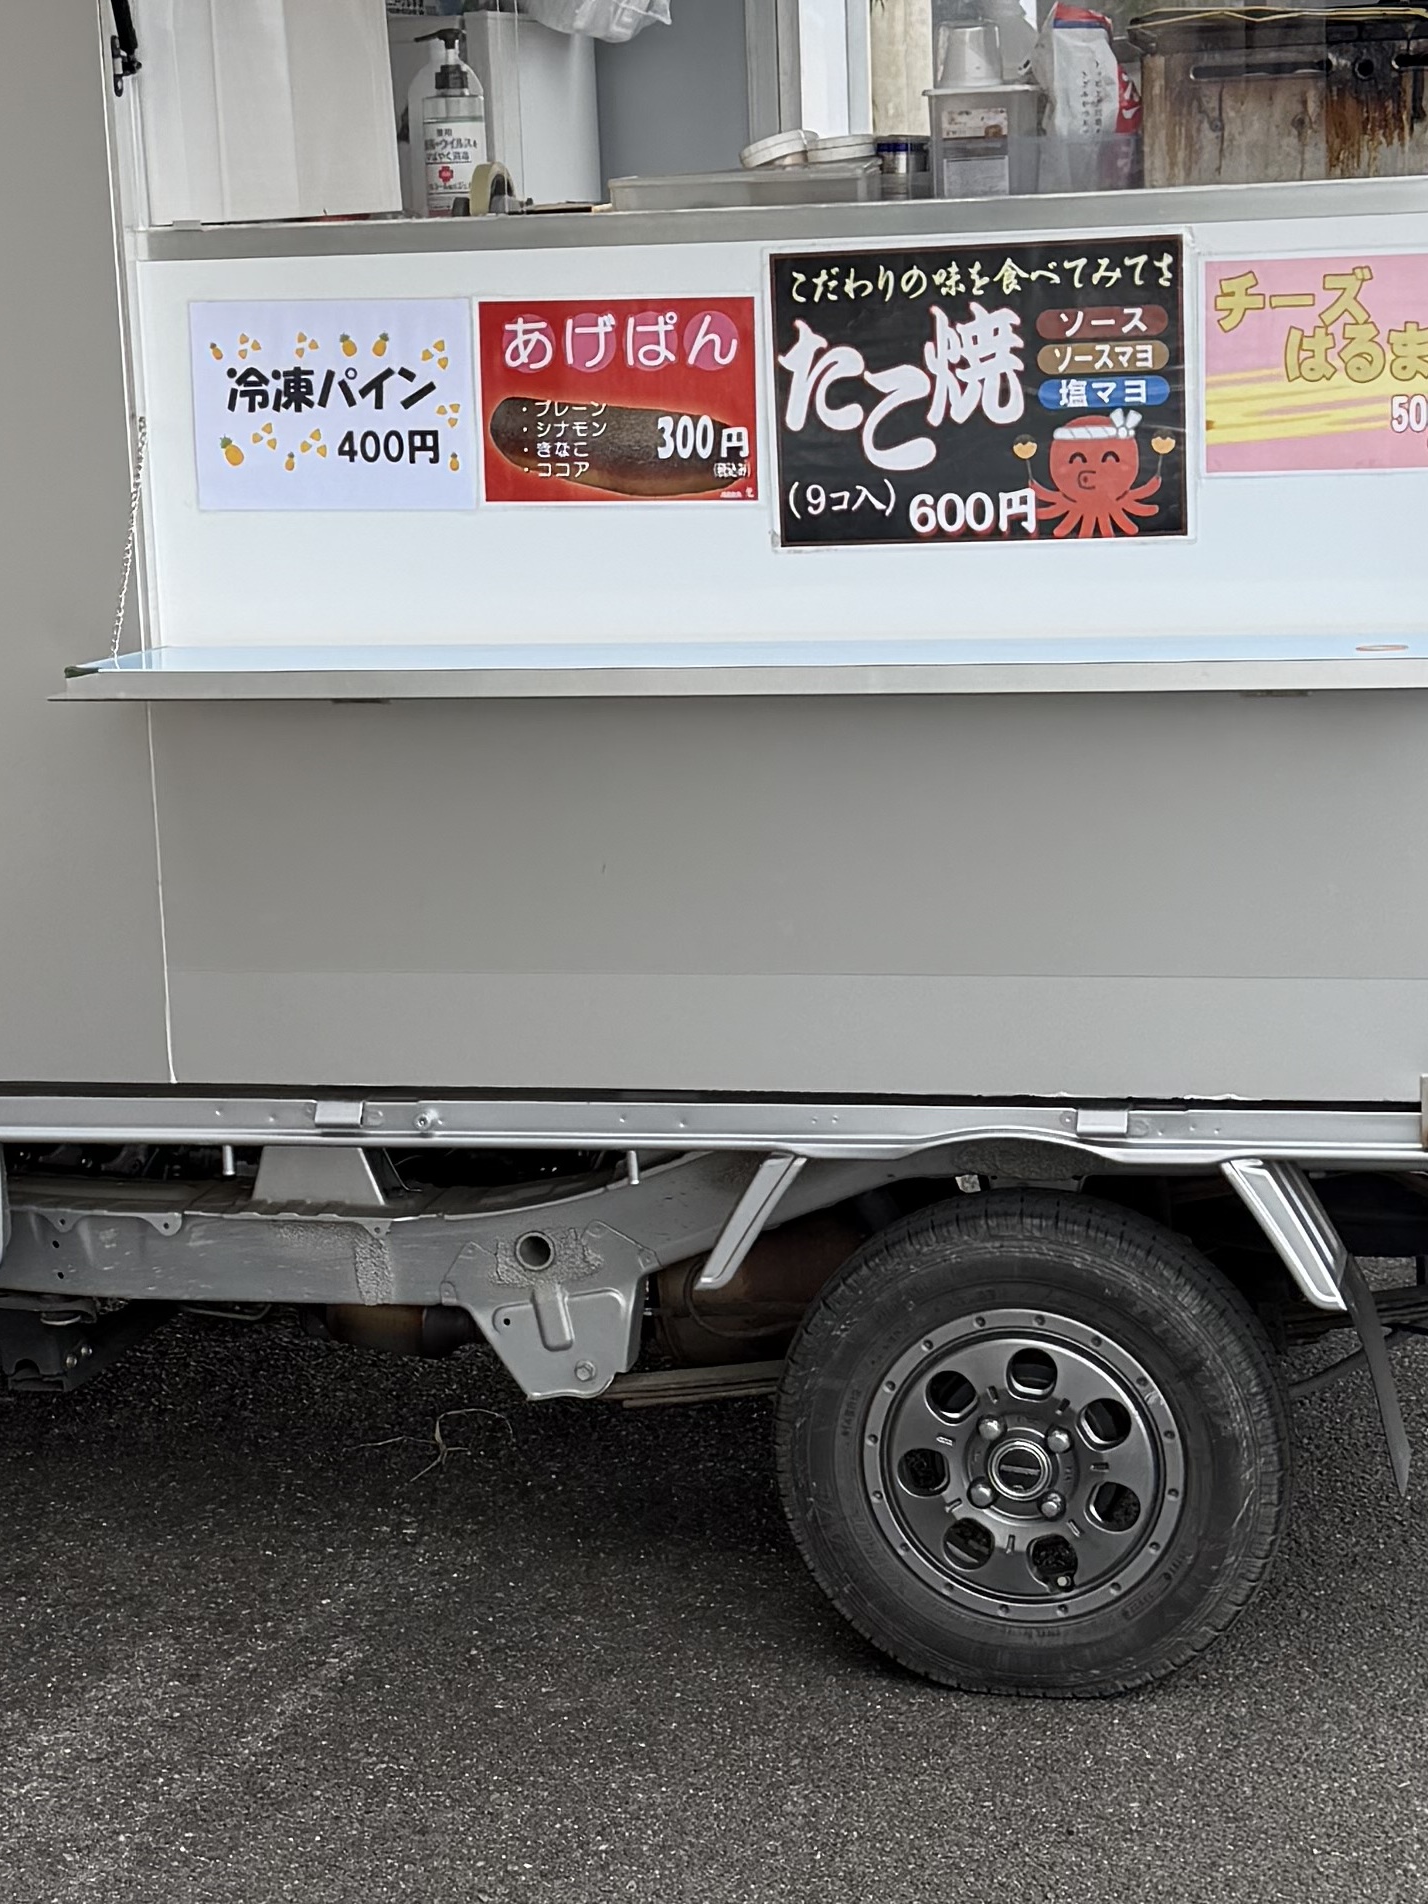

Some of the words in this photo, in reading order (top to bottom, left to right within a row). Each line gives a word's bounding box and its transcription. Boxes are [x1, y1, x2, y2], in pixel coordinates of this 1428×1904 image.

[1215, 266, 1373, 333] チーズ
[503, 310, 739, 370] あげぱん
[1060, 307, 1148, 338] ソース
[1055, 344, 1153, 373] ソースマヨ
[225, 365, 436, 414] 冷凍パイン
[778, 301, 1025, 471] たこ焼
[1059, 379, 1147, 408] 塩マヨ
[338, 429, 440, 464] 400円
[657, 415, 749, 459] 300円
[788, 479, 895, 518] (9コ入)
[909, 488, 1037, 534] 600円
